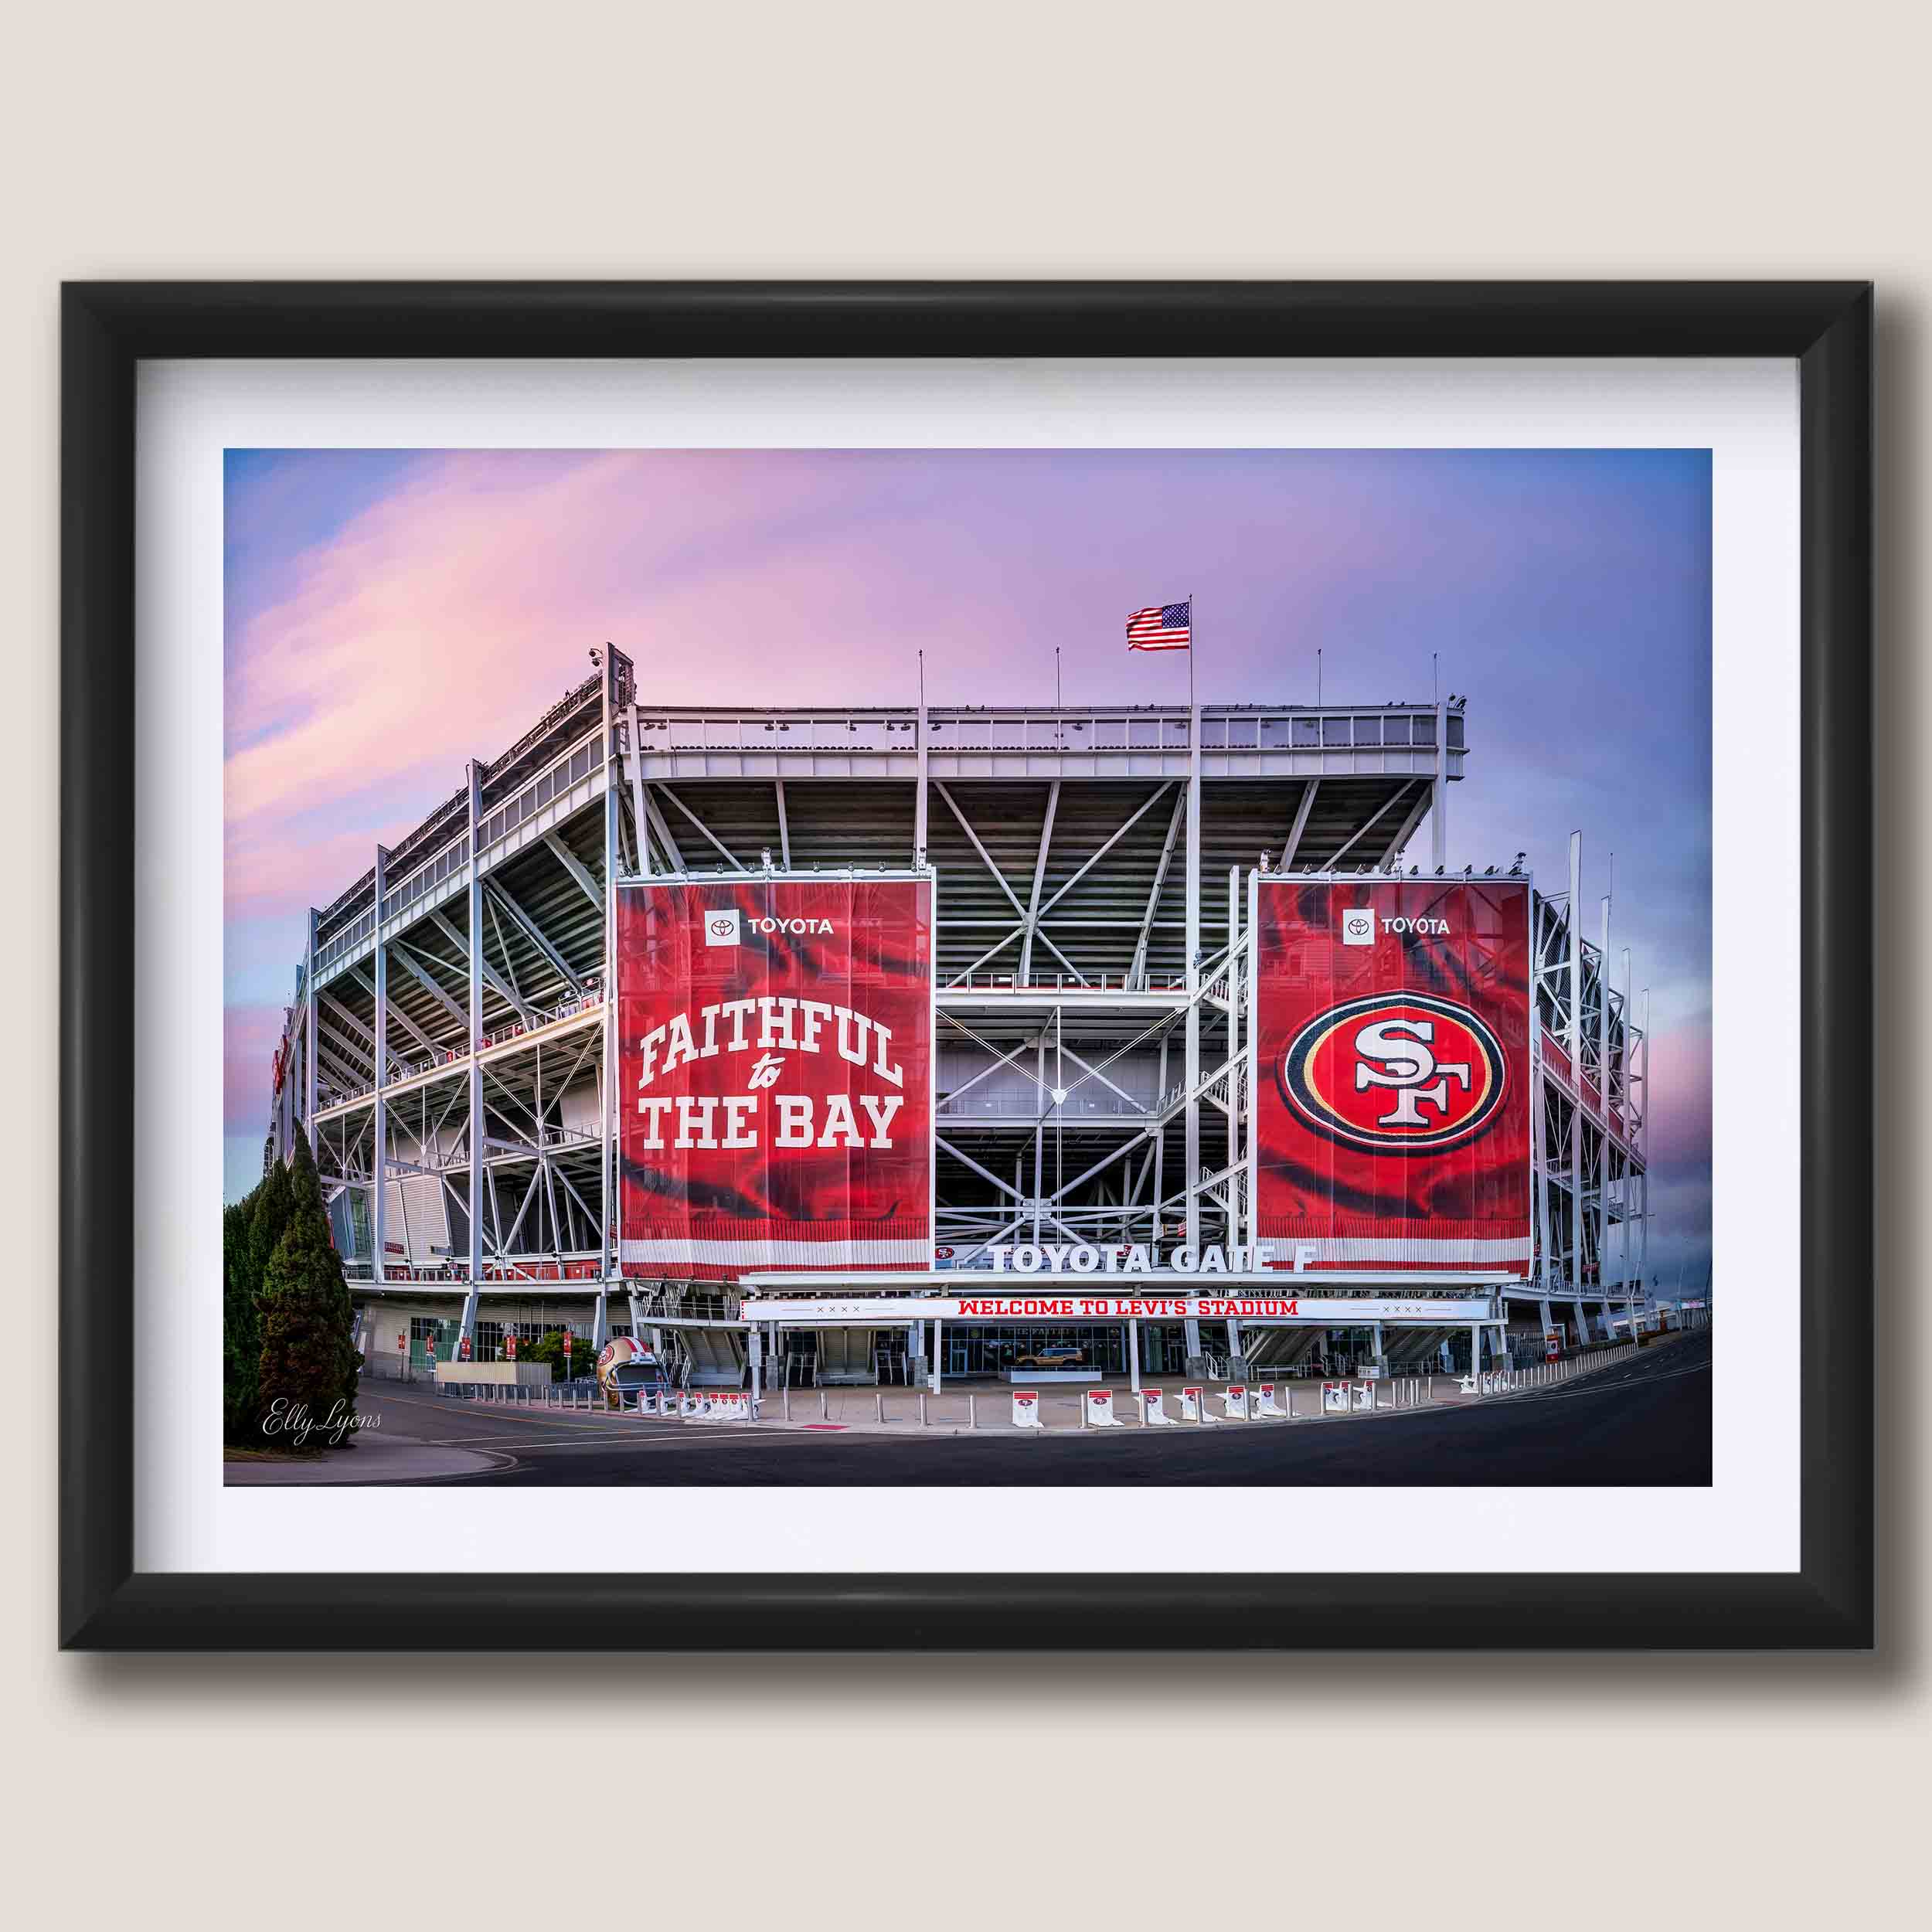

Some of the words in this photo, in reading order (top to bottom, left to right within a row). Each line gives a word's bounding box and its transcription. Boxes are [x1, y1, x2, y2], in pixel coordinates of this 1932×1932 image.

[747, 917, 834, 934] TOYOTA
[1381, 917, 1451, 934] TOYOTA
[638, 996, 904, 1090] FAITHFUL
[747, 1052, 786, 1090] to
[638, 1094, 758, 1150] THE
[774, 1094, 904, 1149] BAY
[988, 1244, 1152, 1274] TOYOTA
[1170, 1243, 1274, 1274] GATE
[1293, 1245, 1317, 1274] F
[957, 1300, 1073, 1315] WELCOME
[1080, 1300, 1109, 1315] TO
[1115, 1300, 1187, 1315] LEVI'S
[1199, 1300, 1299, 1315] STADIUM
